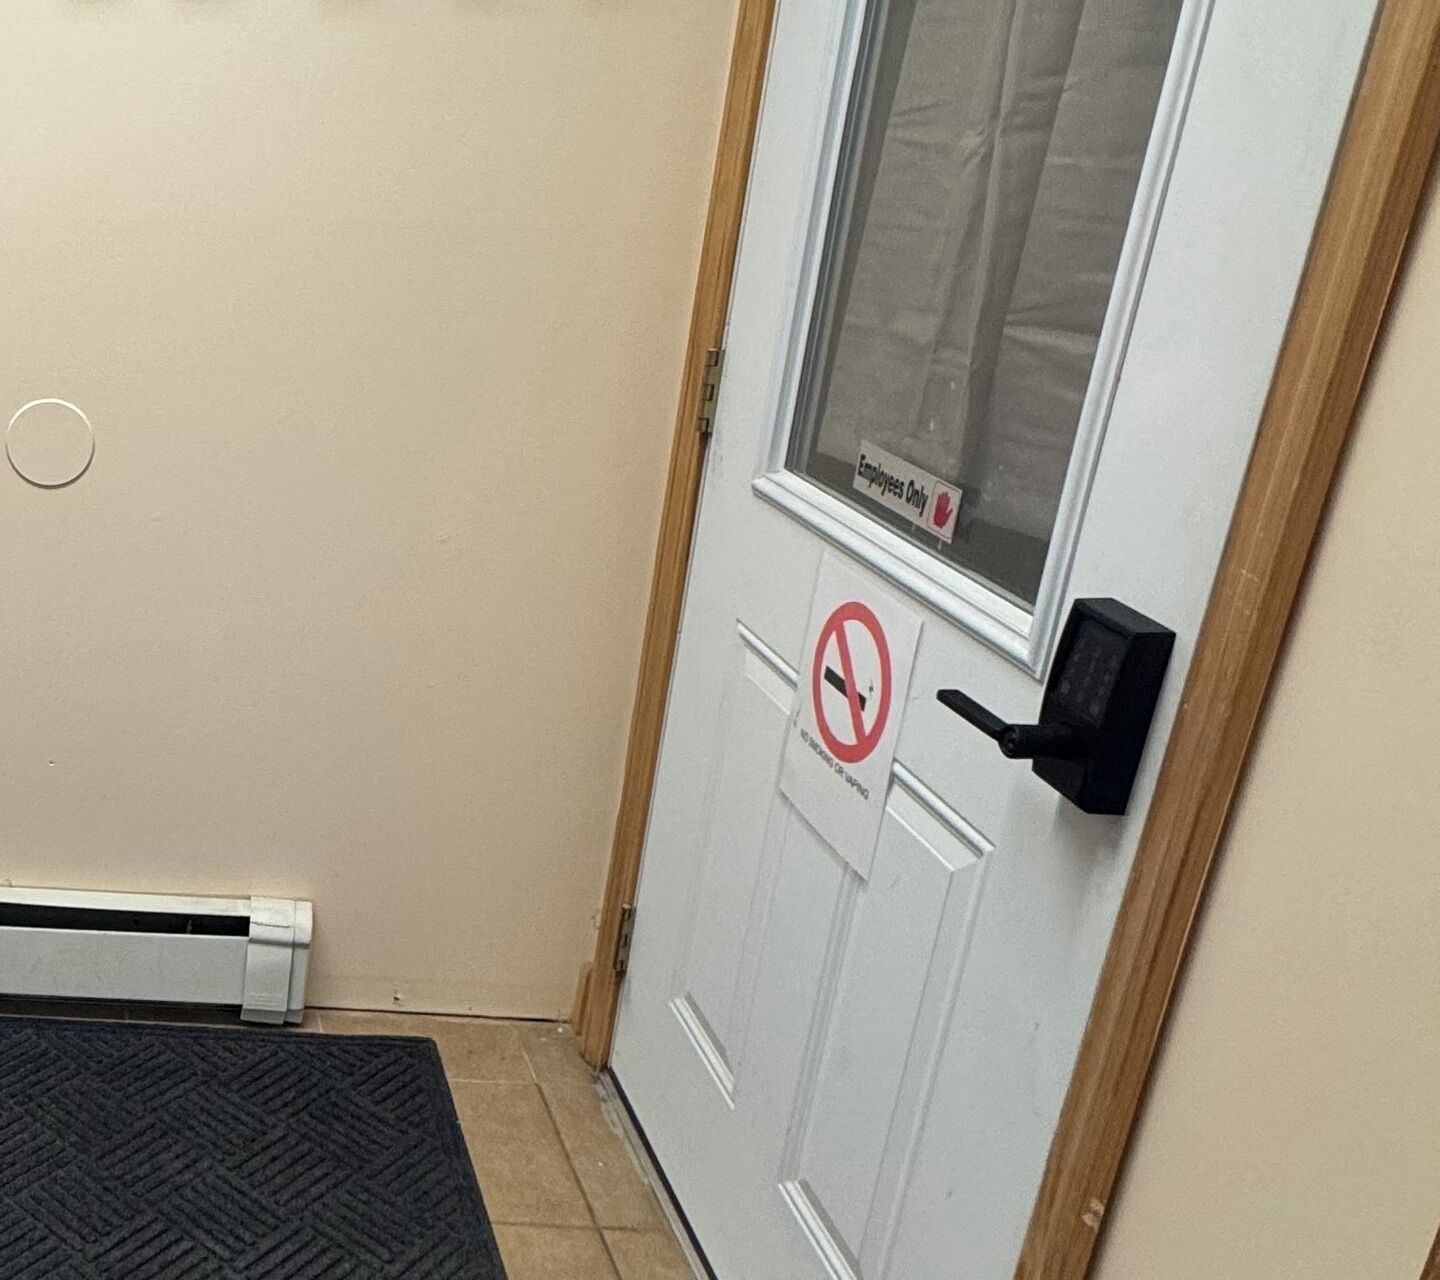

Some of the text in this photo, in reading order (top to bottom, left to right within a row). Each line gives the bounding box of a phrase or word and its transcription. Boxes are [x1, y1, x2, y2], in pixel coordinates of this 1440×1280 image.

[858, 454, 929, 517] Employees Only
[801, 728, 809, 742] NO
[808, 737, 833, 768] SMOKING
[833, 763, 844, 778] OR
